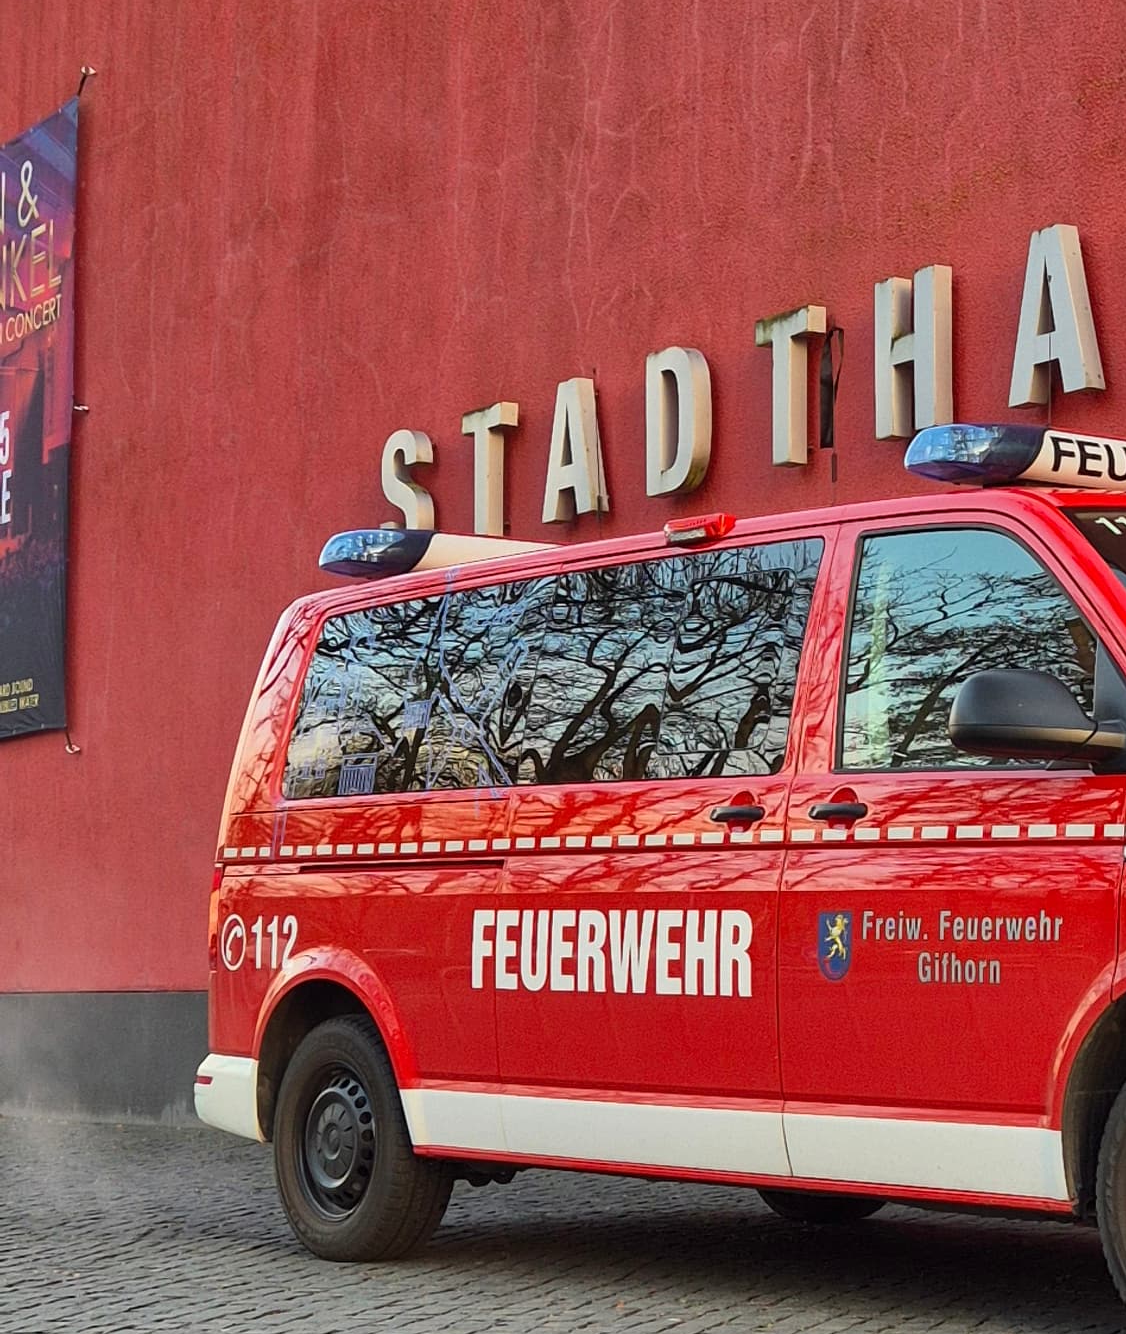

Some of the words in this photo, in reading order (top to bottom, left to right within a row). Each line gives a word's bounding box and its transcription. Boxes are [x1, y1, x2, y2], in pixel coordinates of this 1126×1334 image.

[5, 293, 62, 342] CONCERT
[250, 914, 299, 970] 112
[861, 910, 929, 942] Freiw.
[939, 909, 1064, 942] Feuerwehr
[470, 909, 754, 998] FEUERWEHR
[917, 951, 1002, 985] Gifhorn
